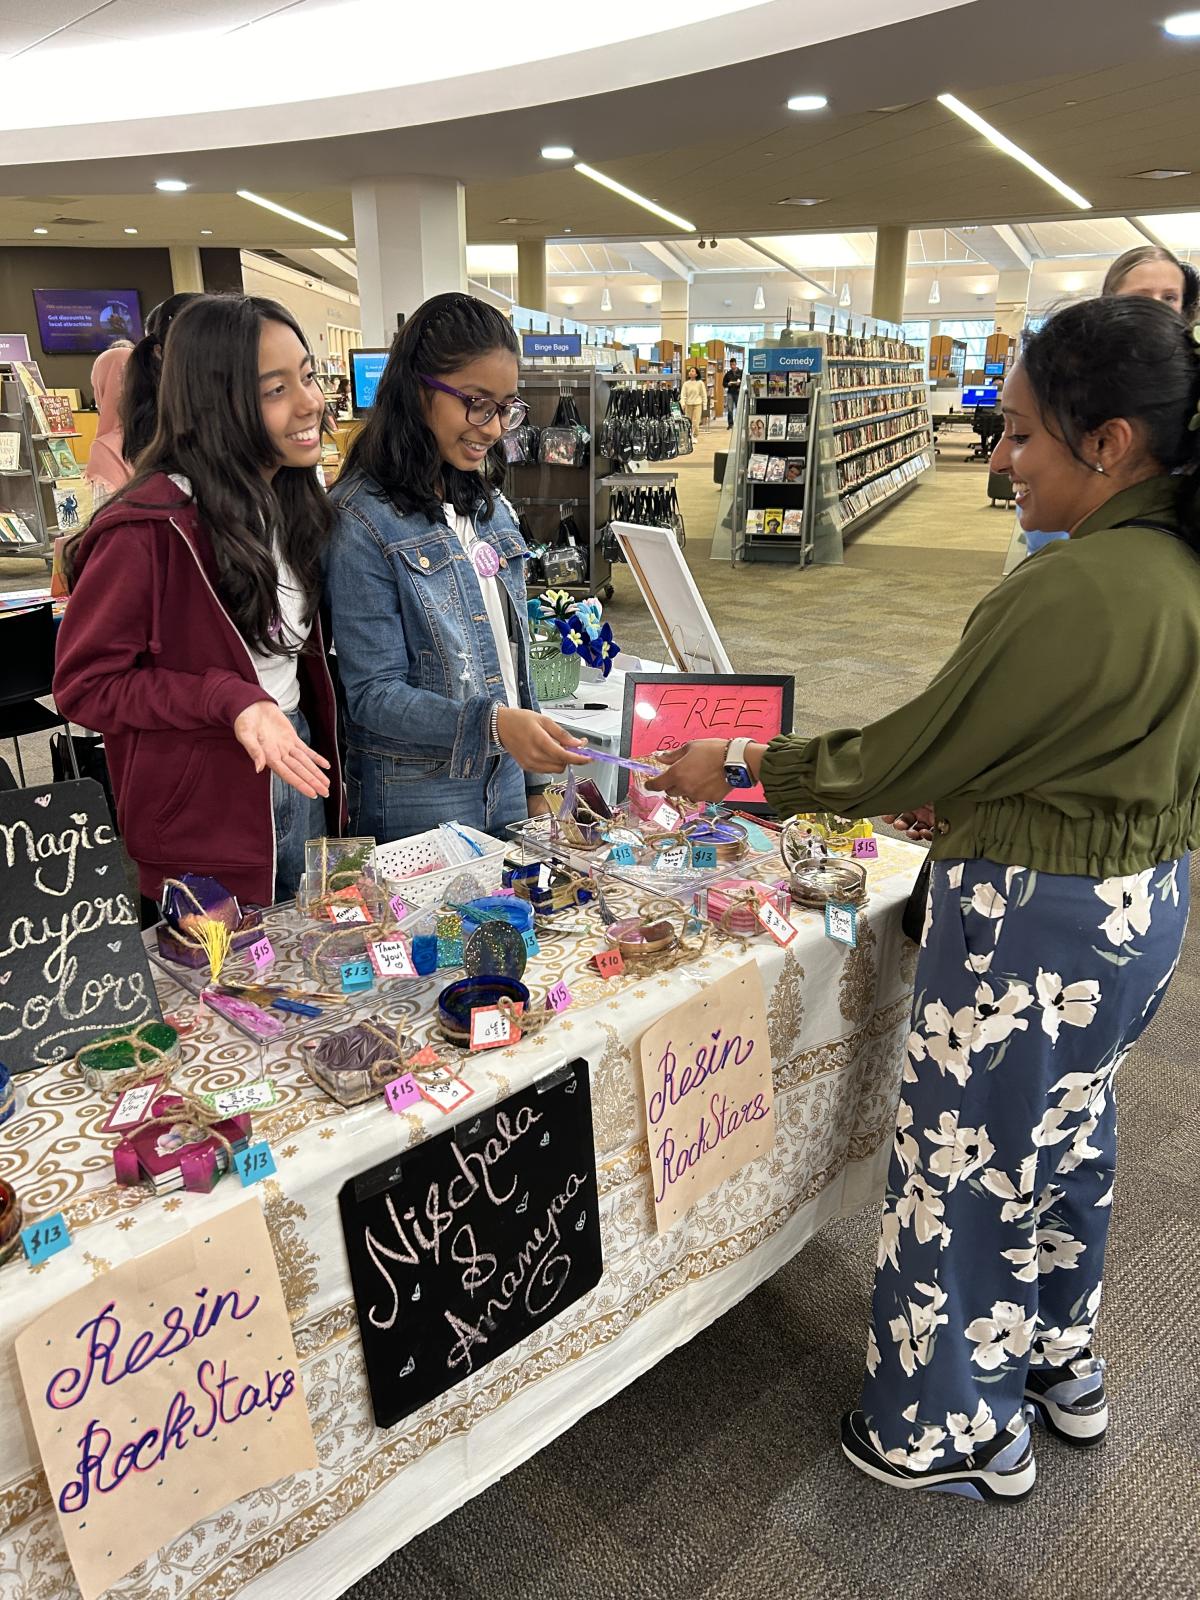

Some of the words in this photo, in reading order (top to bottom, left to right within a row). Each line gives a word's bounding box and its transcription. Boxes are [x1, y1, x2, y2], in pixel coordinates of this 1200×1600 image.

[534, 343, 552, 352] Binge
[553, 343, 570, 352] Bags
[779, 356, 814, 366] Comedy
[647, 688, 768, 729] FREE
[0, 813, 116, 896] Magic
[615, 848, 631, 861] $13
[694, 850, 712, 862] $13
[857, 841, 876, 852] $15
[392, 901, 405, 916] $15
[0, 893, 138, 983] ayers
[375, 943, 400, 953] Thank
[254, 945, 270, 962] $15
[601, 956, 619, 968] $10
[344, 966, 369, 978] $13
[551, 988, 567, 1008] $15
[650, 1029, 755, 1125] Resin
[391, 1078, 414, 1102] $15
[243, 1151, 268, 1176] $13
[366, 1106, 543, 1330] Nischala
[30, 1225, 62, 1254] $13
[451, 1224, 497, 1298] &
[46, 1287, 260, 1410] Resin
